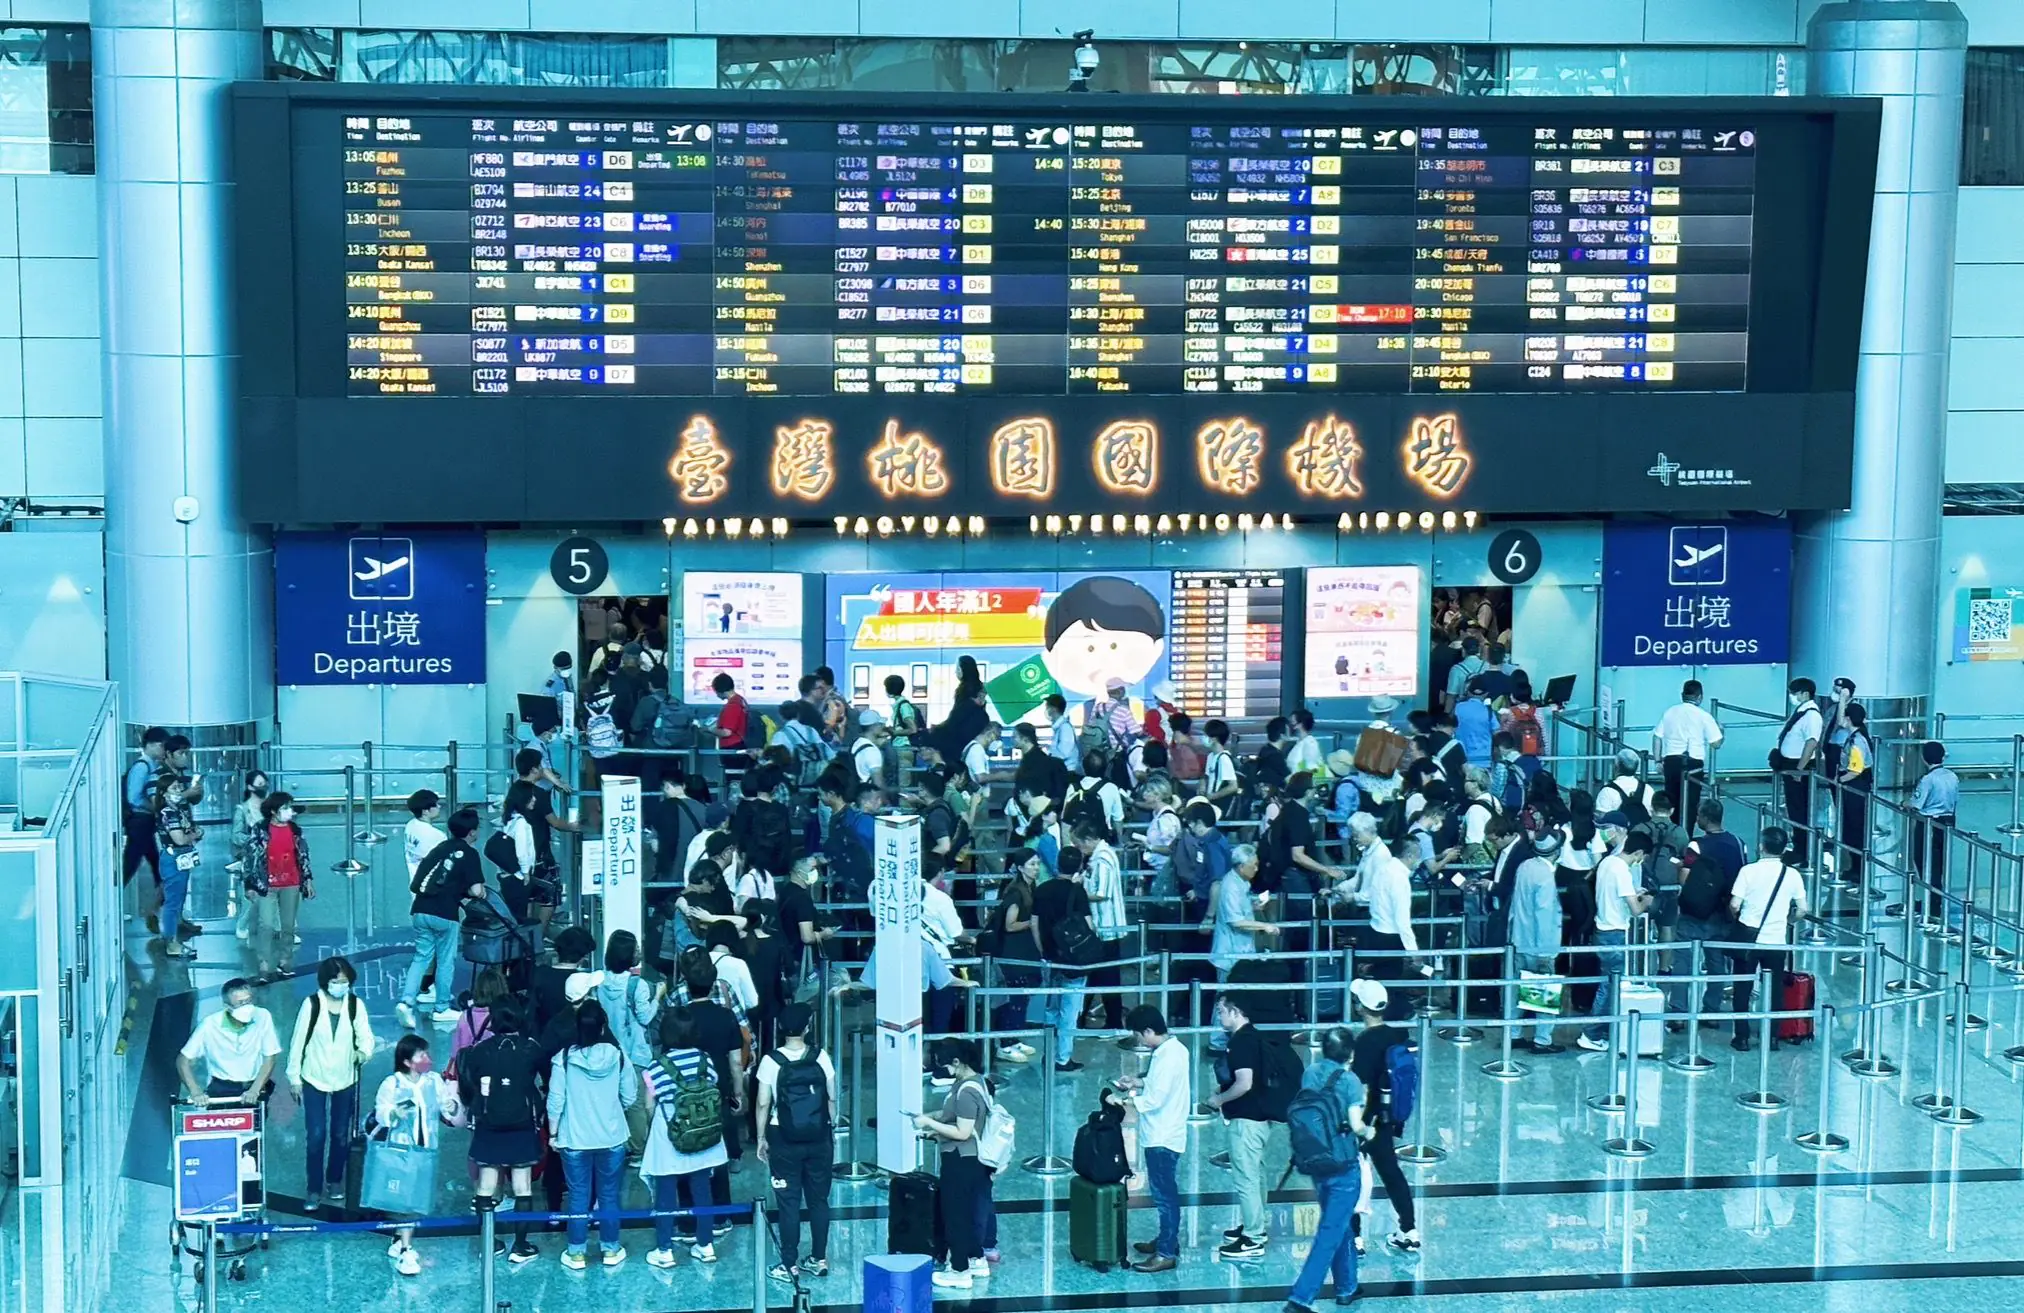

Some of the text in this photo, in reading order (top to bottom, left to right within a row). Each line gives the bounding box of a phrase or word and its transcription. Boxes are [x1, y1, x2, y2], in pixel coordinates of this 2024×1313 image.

[345, 151, 376, 163] 13:05
[587, 154, 596, 165] 5
[609, 155, 627, 166] D6
[676, 154, 706, 166] 13:08
[715, 156, 745, 166] 14:30
[969, 159, 986, 169] D3
[1035, 159, 1063, 169] 14:40
[1072, 157, 1100, 169] 15:20
[1318, 161, 1334, 170] C7
[1418, 160, 1446, 170] 19:35
[1659, 161, 1675, 171] C3
[345, 182, 376, 194] 13:25
[584, 185, 600, 196] 24
[609, 186, 627, 198] C4
[1071, 189, 1100, 199] 15:25
[1418, 190, 1445, 201] 19:40
[1445, 205, 1475, 213] Toronto
[346, 213, 377, 225] 13:30
[584, 216, 601, 228] 23
[716, 217, 745, 228] 14:50
[1034, 218, 1062, 230] 14:40
[1071, 219, 1100, 230] 15:30
[1416, 219, 1443, 230] 19:40
[944, 220, 960, 230] 20
[1296, 221, 1305, 231] 2
[378, 229, 410, 238] Incheon
[1444, 234, 1455, 242] San
[346, 244, 377, 256] 13:35
[584, 247, 601, 258] 20
[347, 276, 378, 288] 14:00
[610, 278, 627, 289] C1
[716, 277, 745, 289] 14:50
[969, 279, 985, 289] D6
[1291, 279, 1307, 290] 21
[1415, 279, 1442, 289] 20:00
[1631, 279, 1646, 290] 19
[348, 306, 379, 318] 14:10
[589, 308, 597, 320] 7
[943, 309, 959, 319] 21
[1291, 309, 1306, 319] 21
[1414, 308, 1441, 319] 20:30
[1629, 308, 1644, 319] 21
[348, 337, 379, 349] 14:20
[1294, 339, 1303, 349] 7
[349, 368, 380, 380] 14:20
[611, 369, 627, 380] D7
[671, 415, 1473, 499] 臺灣桃園國際機場
[663, 511, 1477, 534] TAIWAN TAOYUAN INTERNATIONAL AIRPORT
[1504, 539, 1525, 574] 6
[568, 548, 591, 583] 5
[1664, 594, 1731, 629] 出境
[346, 611, 421, 646] 出境
[1634, 635, 1758, 660] Departures
[314, 652, 452, 680] Departures
[621, 794, 636, 876] 出發入口
[607, 817, 620, 886] Departure
[887, 838, 898, 924] 出發入口
[878, 858, 886, 930] Departure
[191, 1117, 246, 1129] SHARP
